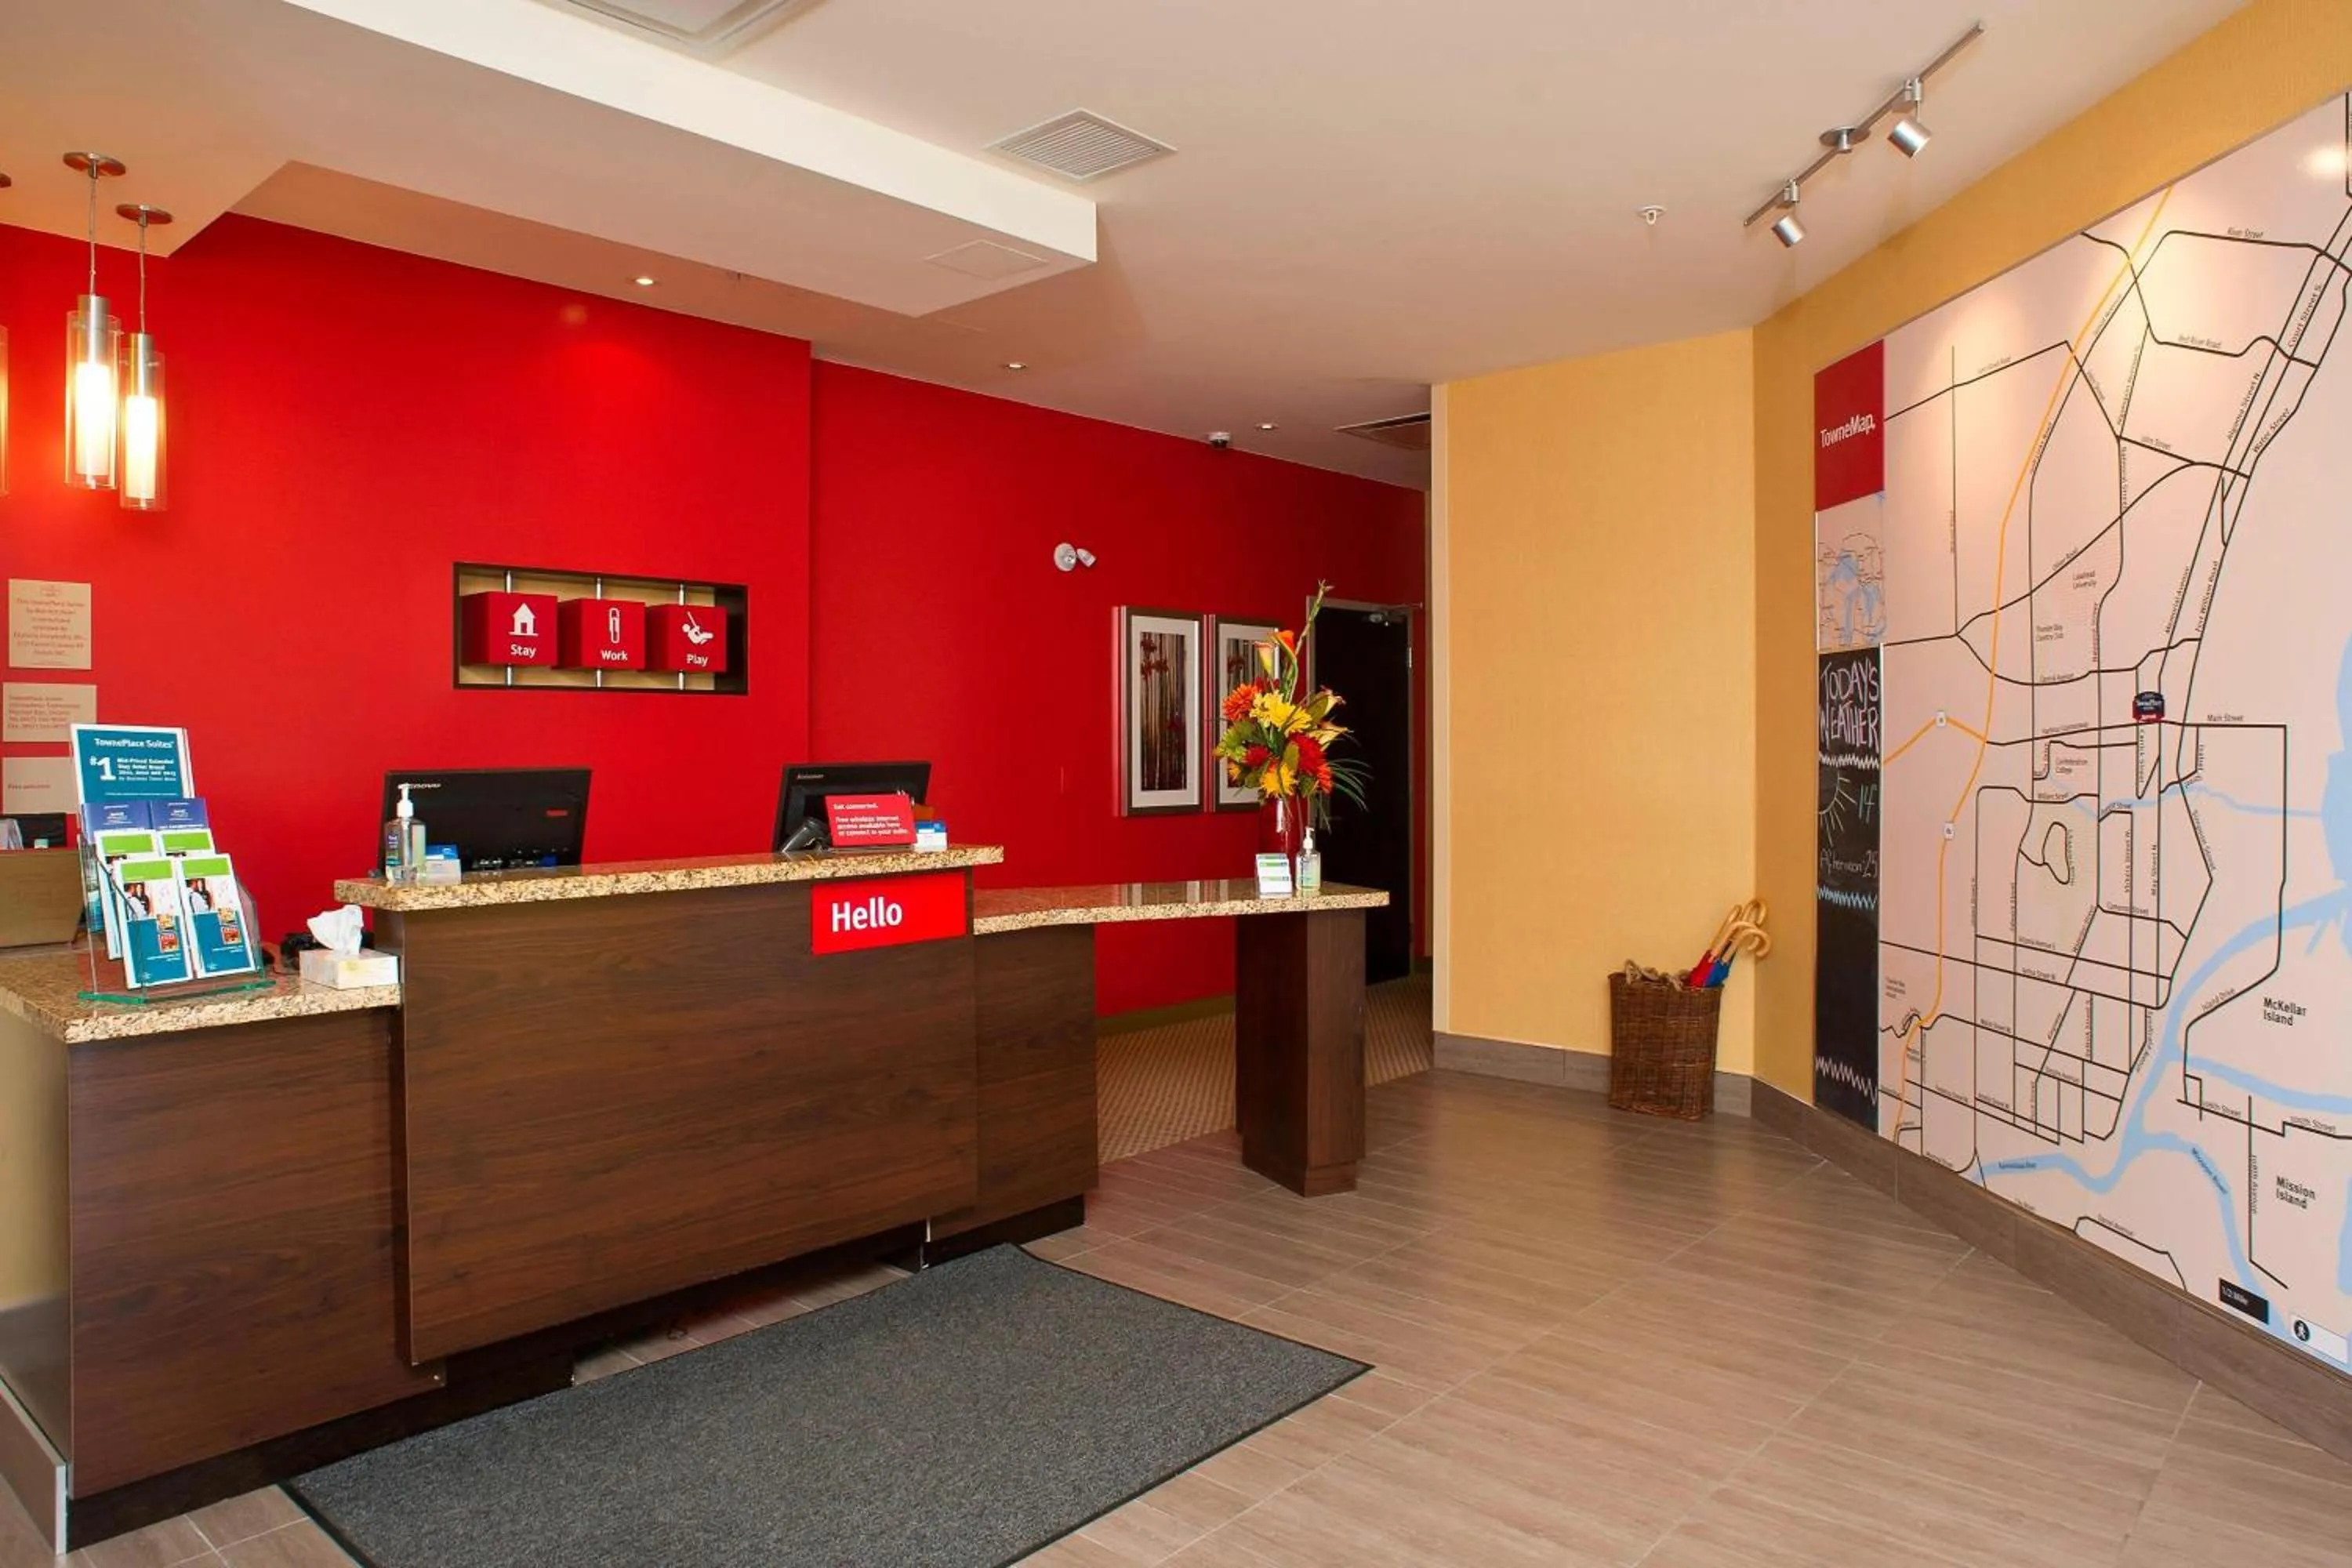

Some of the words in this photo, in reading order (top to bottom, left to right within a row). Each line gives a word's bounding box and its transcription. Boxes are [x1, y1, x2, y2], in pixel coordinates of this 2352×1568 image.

[510, 644, 536, 658] Stay
[601, 649, 628, 661] Work
[687, 653, 707, 666] Play
[831, 896, 902, 933] Hello
[2263, 996, 2307, 1017] McKellar
[2263, 1009, 2293, 1026] Island
[2276, 1175, 2315, 1201] Mission
[2276, 1188, 2307, 1210] Island
